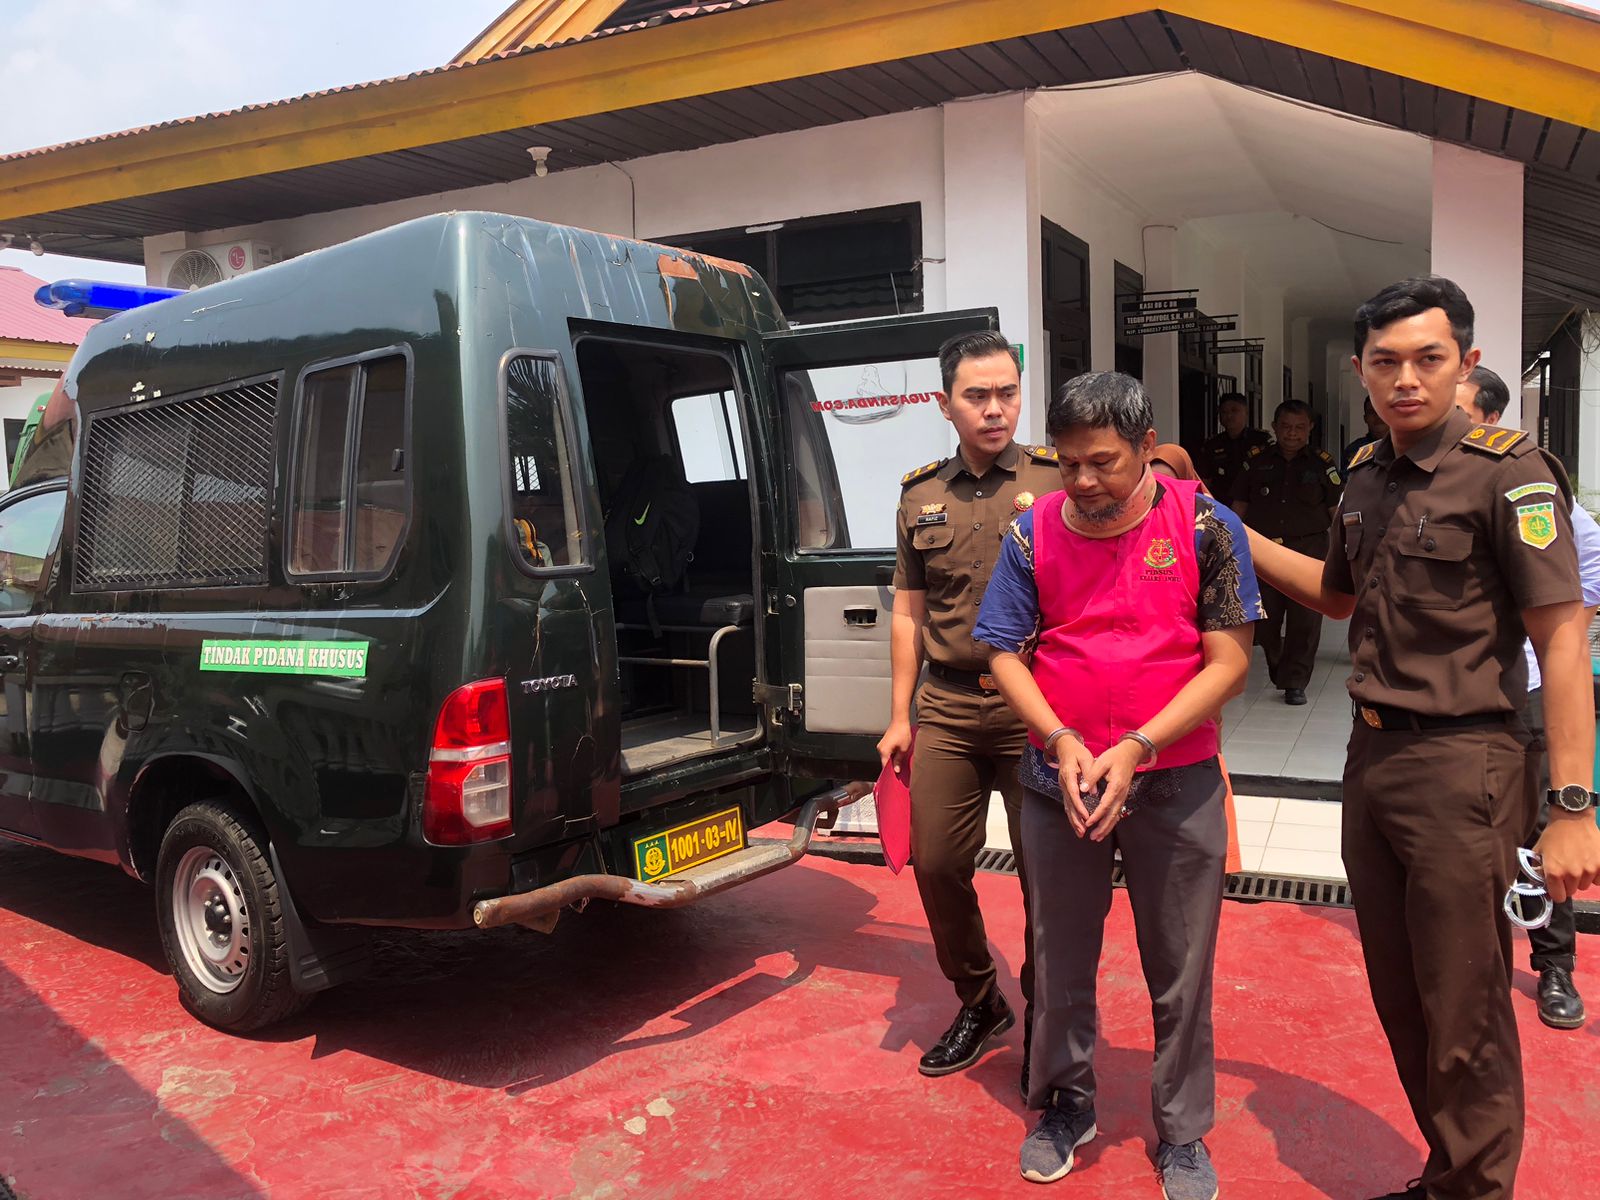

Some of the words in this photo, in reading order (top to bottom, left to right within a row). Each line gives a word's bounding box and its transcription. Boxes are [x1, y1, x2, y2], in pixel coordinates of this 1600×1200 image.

[203, 646, 250, 665] TINDAK
[253, 647, 304, 667] PIDANA
[307, 648, 365, 669] KHUSUS
[520, 674, 579, 694] TOYOTA
